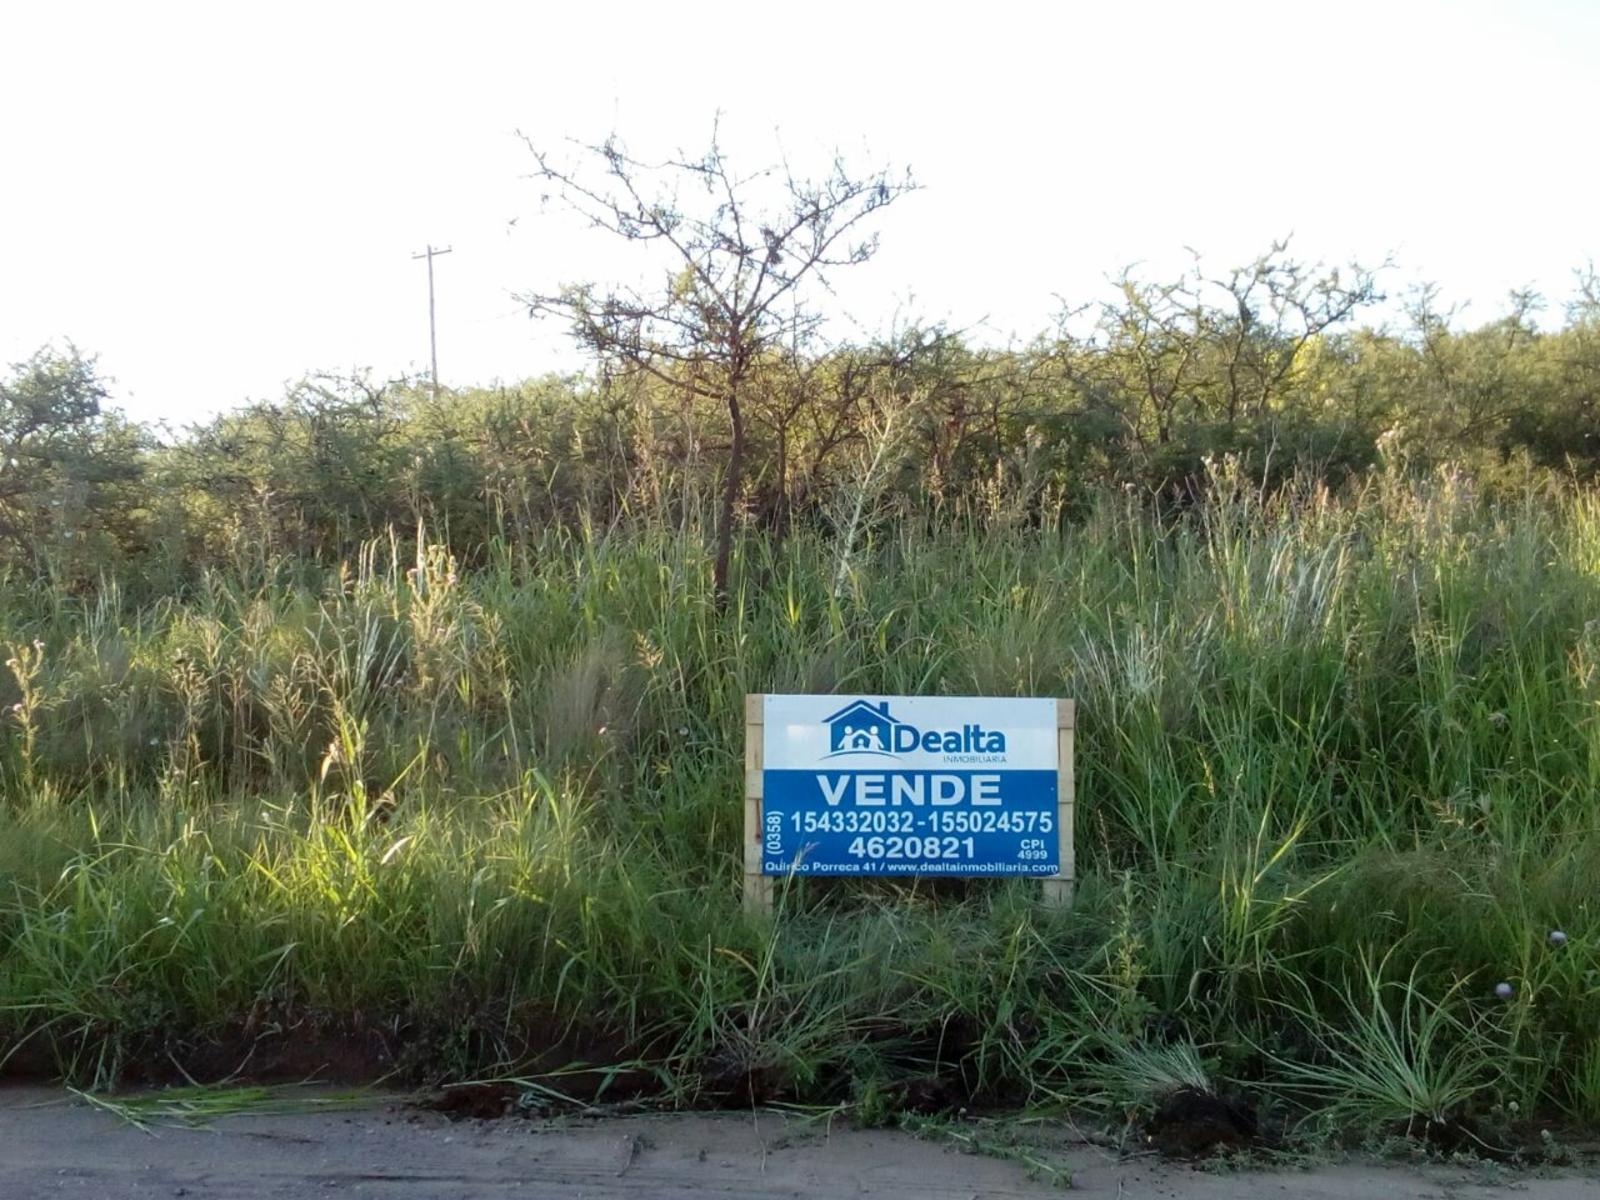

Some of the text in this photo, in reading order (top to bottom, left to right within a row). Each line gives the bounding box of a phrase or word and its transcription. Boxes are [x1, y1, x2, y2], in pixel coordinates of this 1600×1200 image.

[894, 724, 1006, 753] Dealta
[943, 755, 1007, 763] INMOBILIARIA
[816, 774, 1002, 806] VENDE
[766, 811, 784, 855] (0358)
[848, 836, 974, 859] 4620821
[1020, 839, 1045, 849] CPI
[1017, 850, 1048, 860] 4999
[765, 861, 810, 871] Quirco
[812, 861, 860, 871] Porreca
[862, 862, 877, 871] 41
